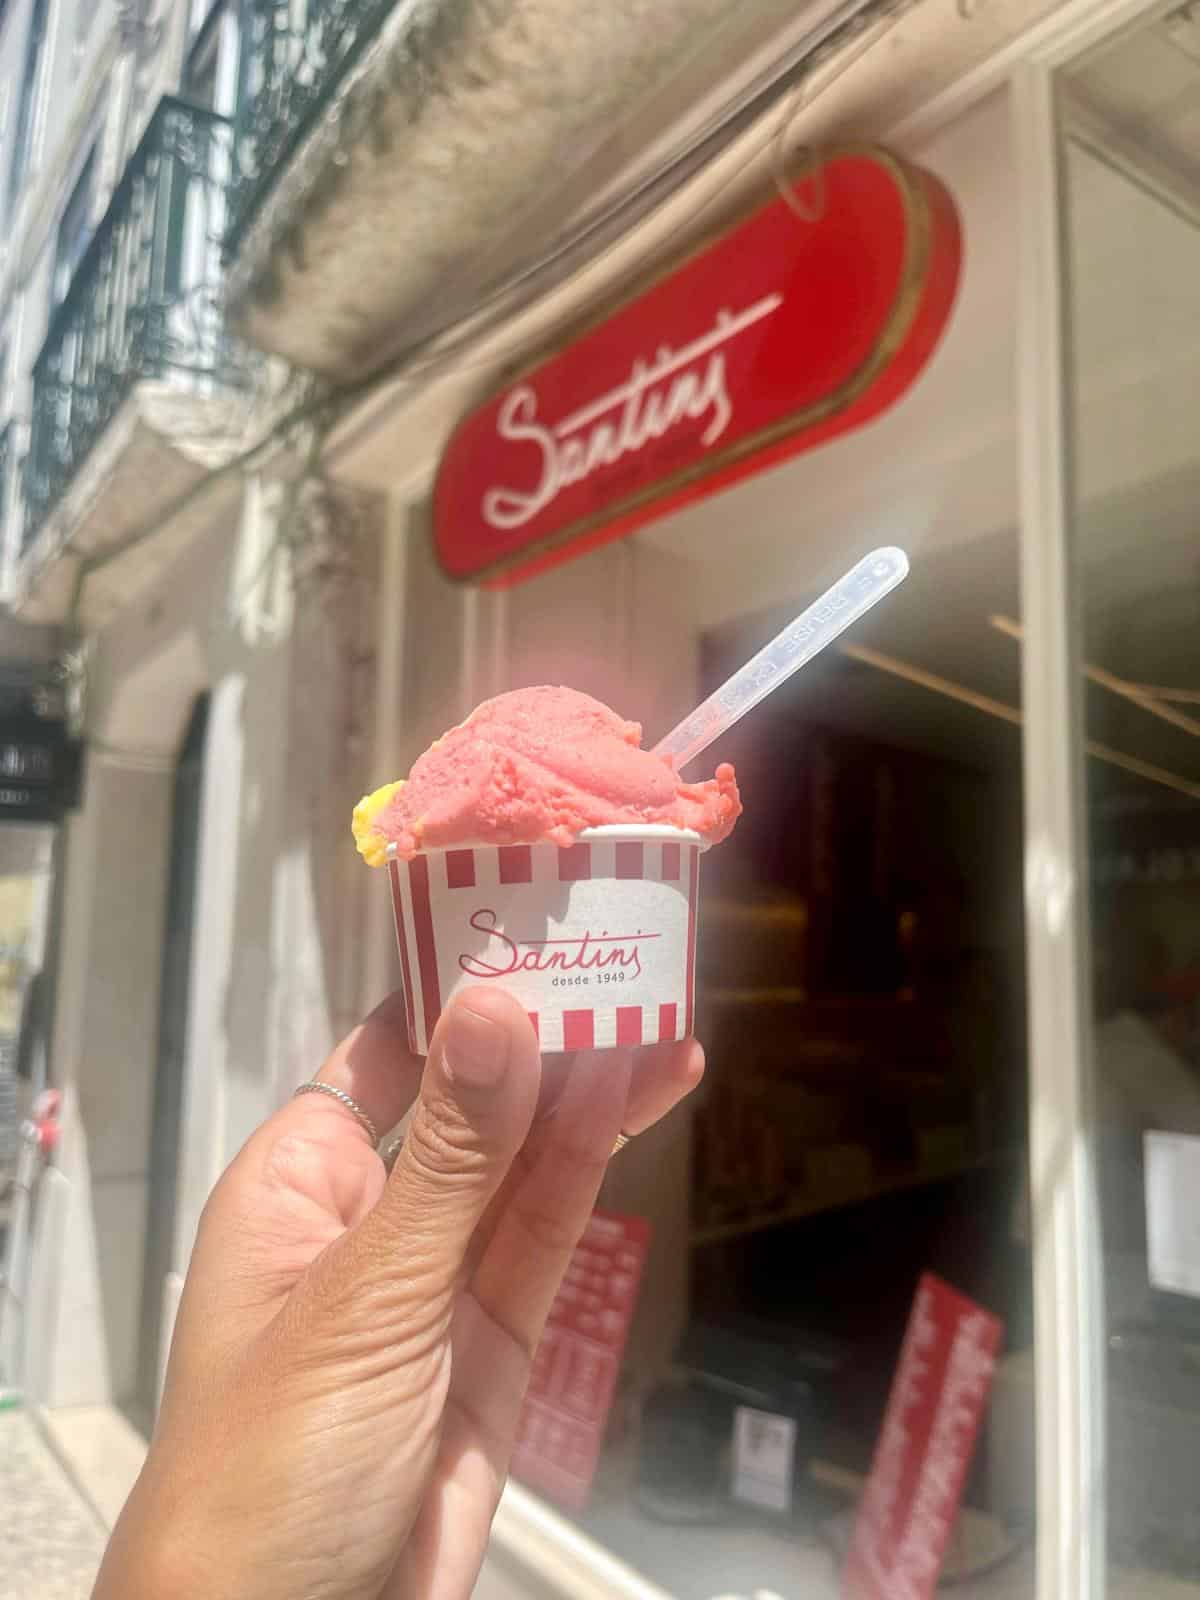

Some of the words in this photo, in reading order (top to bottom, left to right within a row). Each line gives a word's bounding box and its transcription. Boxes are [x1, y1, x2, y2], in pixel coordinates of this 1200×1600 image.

[458, 908, 662, 980] Santini
[551, 973, 589, 986] desde
[596, 971, 626, 985] 1949
